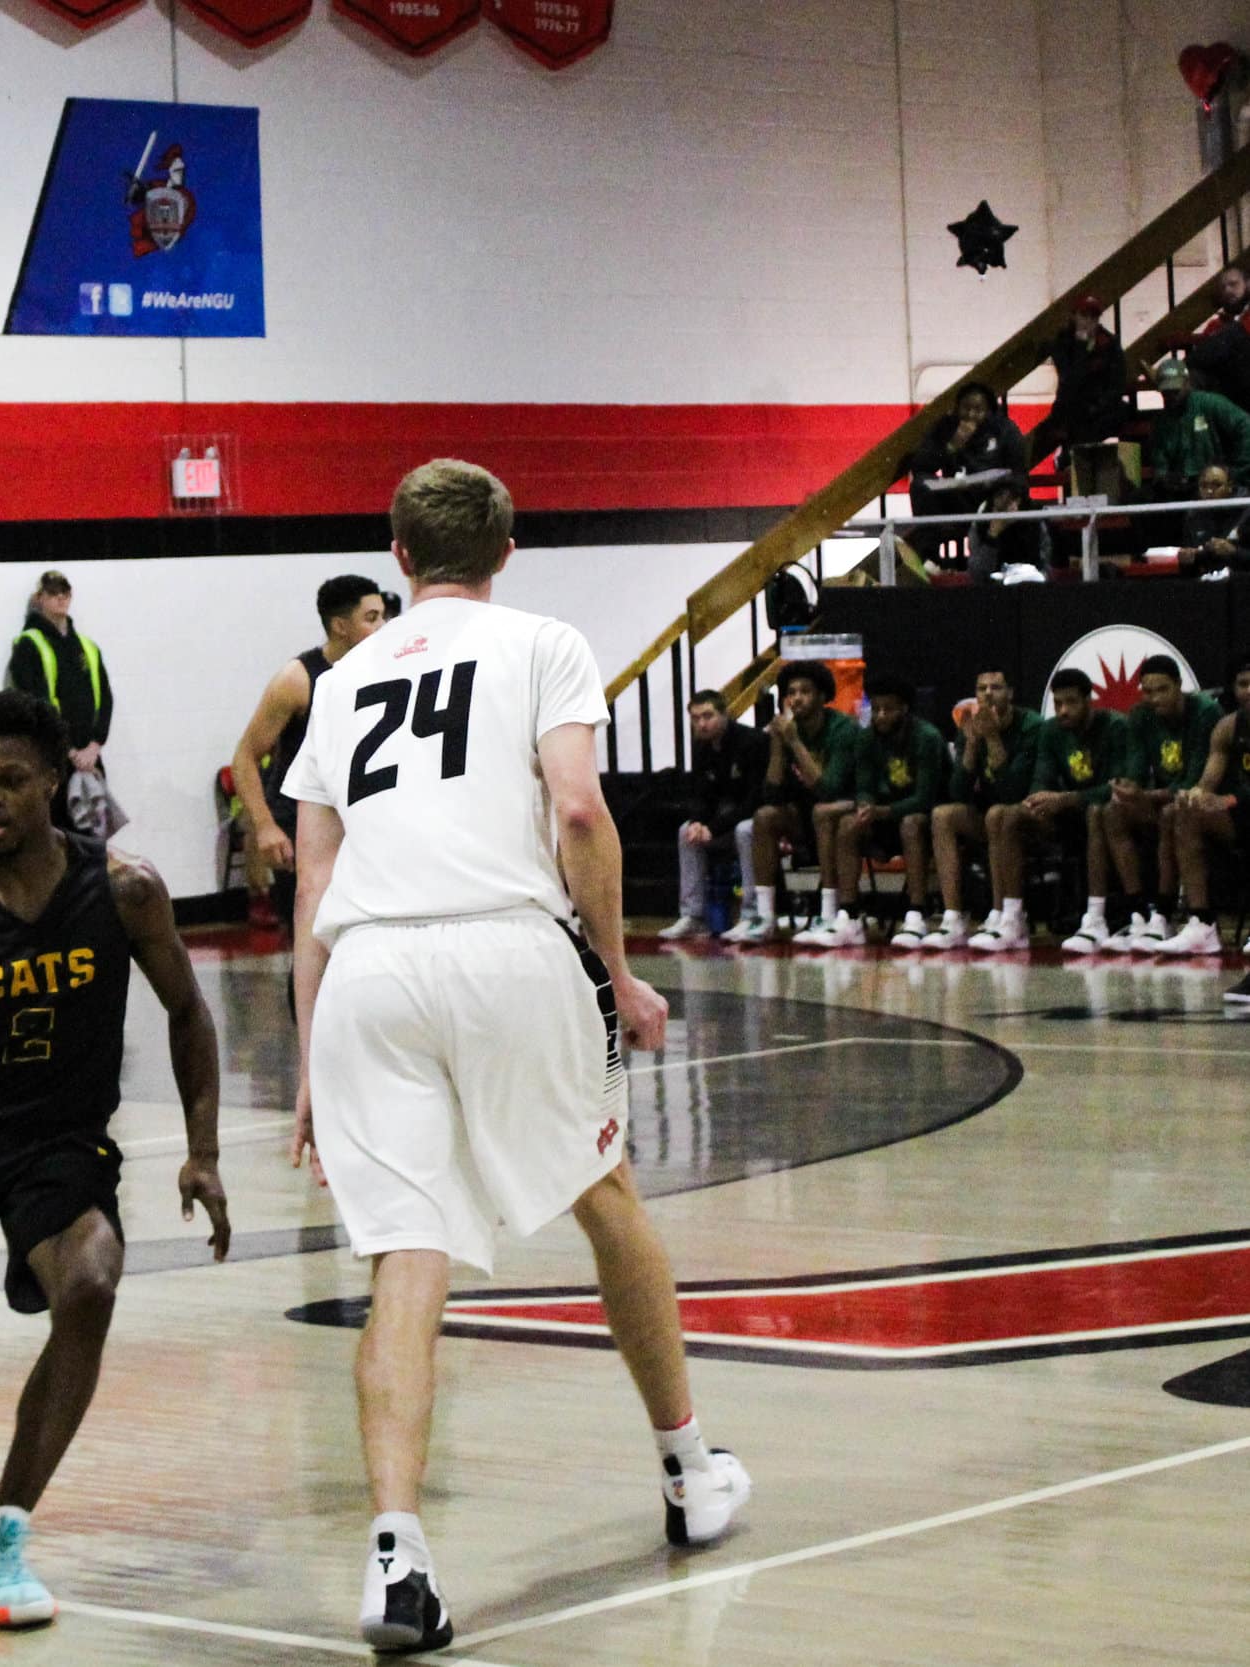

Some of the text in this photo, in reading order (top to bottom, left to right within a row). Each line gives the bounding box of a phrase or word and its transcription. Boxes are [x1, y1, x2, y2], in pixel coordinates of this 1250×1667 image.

[141, 290, 236, 310] #WeAreNGU
[347, 659, 478, 808] 24
[1, 1007, 55, 1064] 2
